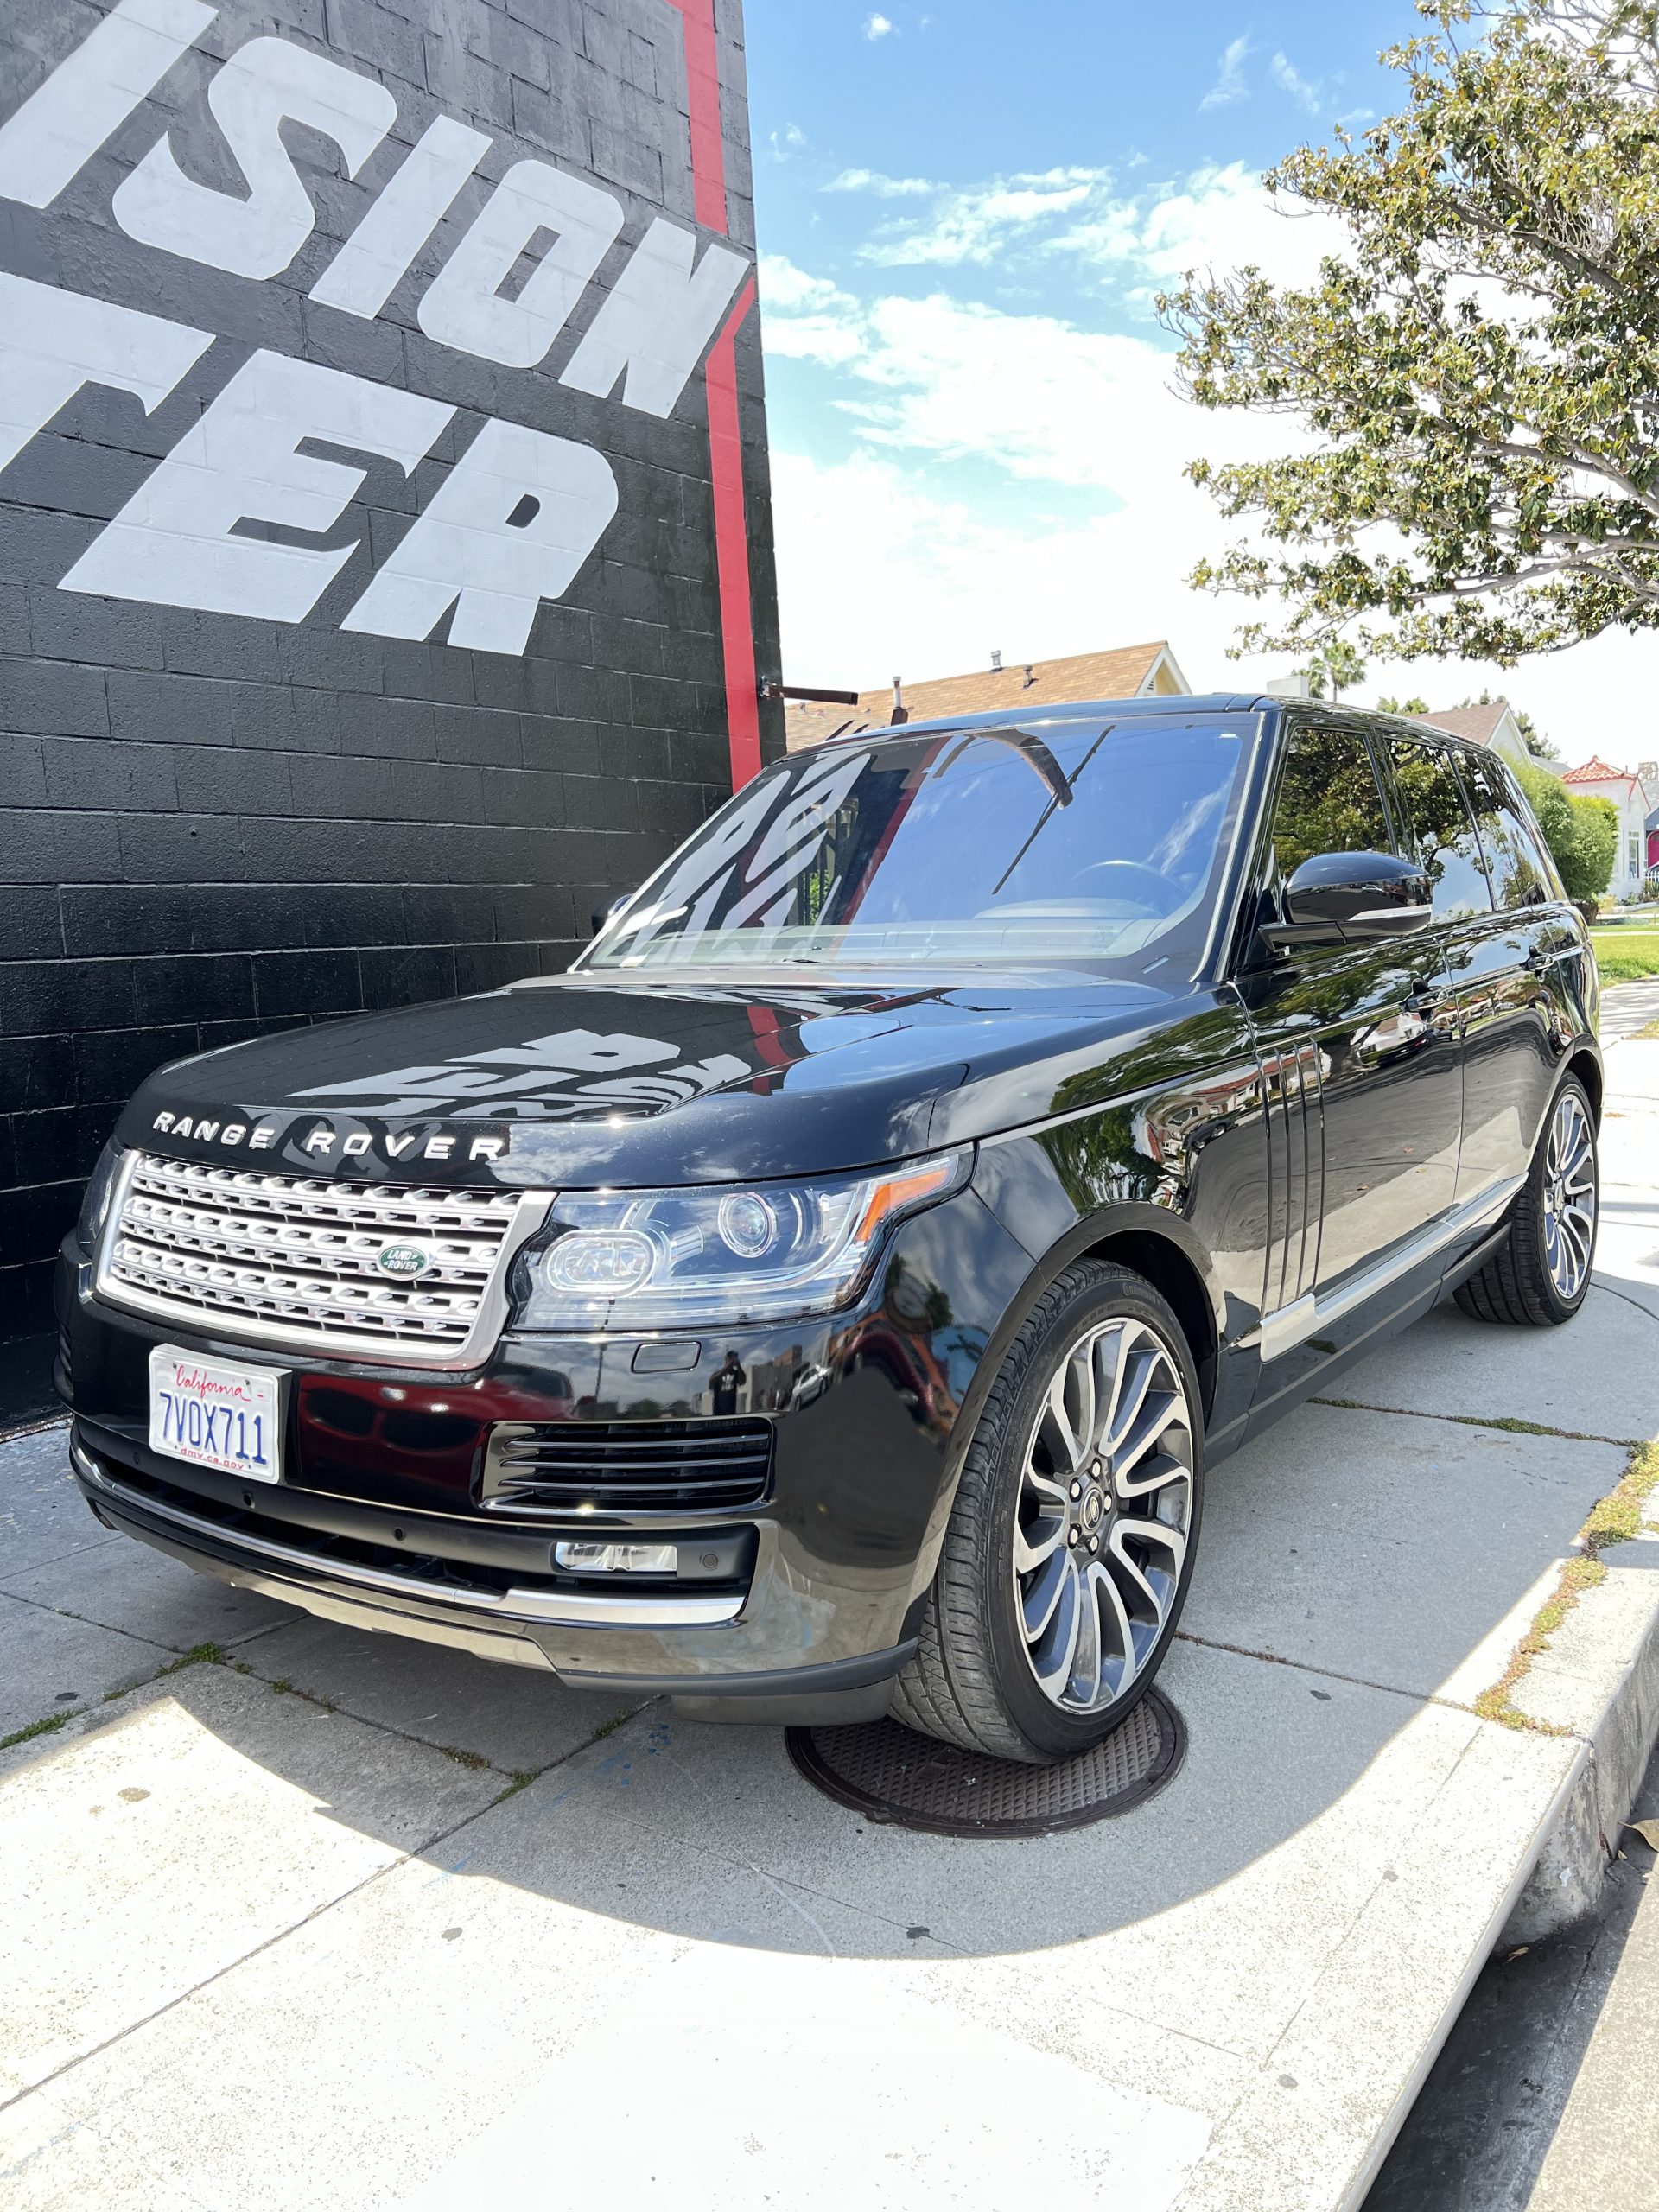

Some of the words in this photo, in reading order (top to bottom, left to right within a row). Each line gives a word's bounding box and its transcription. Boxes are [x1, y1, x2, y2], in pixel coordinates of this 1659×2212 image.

[152, 1111, 275, 1150] RANGE
[306, 1131, 505, 1161] ROVER
[387, 1249, 412, 1261] LAND
[387, 1259, 419, 1271] ROVER
[176, 1365, 251, 1402] California
[181, 1447, 244, 1470] dmv.ca.gov
